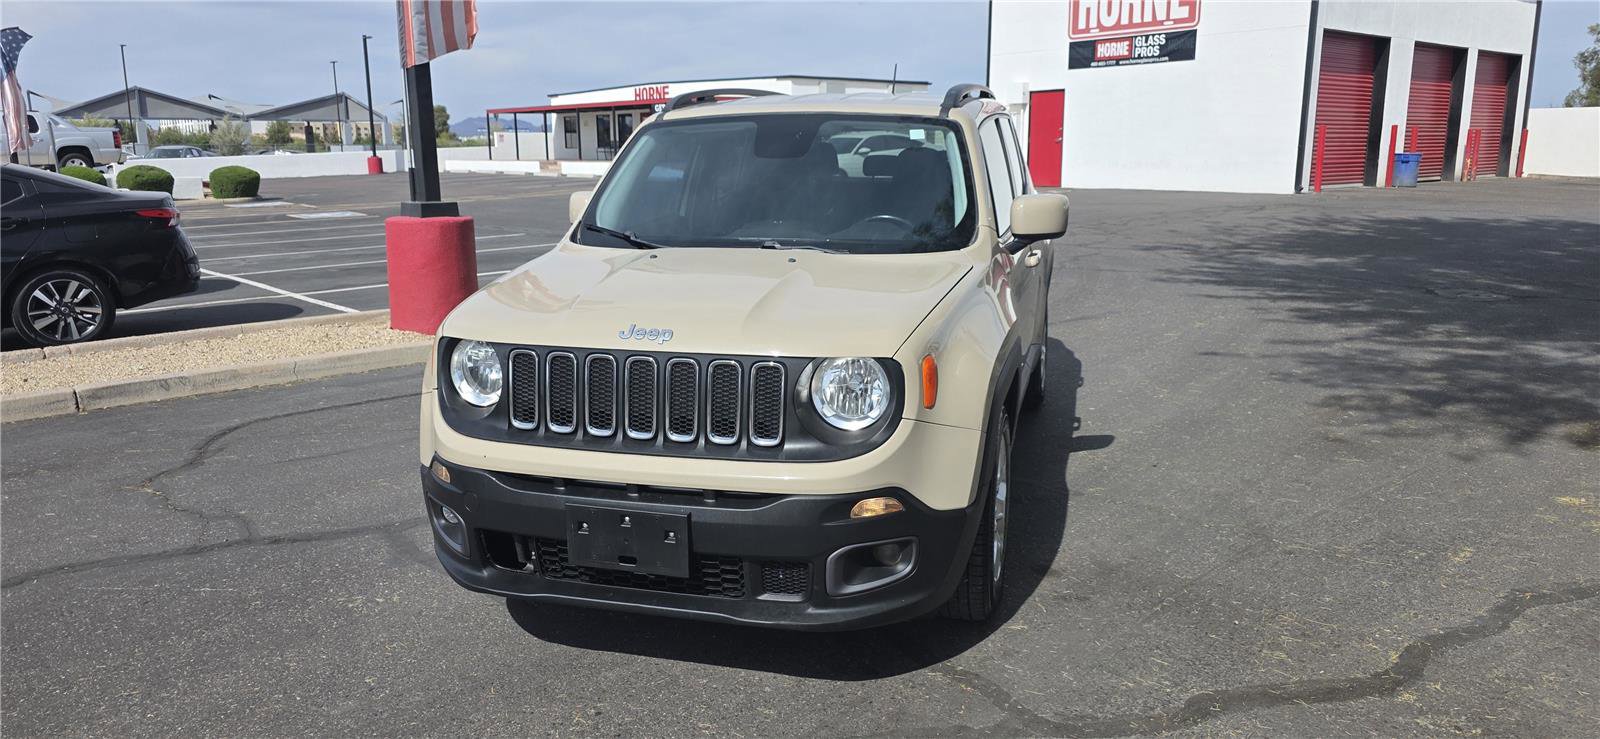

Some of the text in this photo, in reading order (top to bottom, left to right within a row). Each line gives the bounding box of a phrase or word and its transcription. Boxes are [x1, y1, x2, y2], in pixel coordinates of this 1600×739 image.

[1135, 34, 1166, 47] GLASS
[1097, 41, 1129, 57] HORNE
[1134, 45, 1160, 58] PROS
[634, 85, 669, 101] HORNE
[618, 323, 674, 345] Jeep
